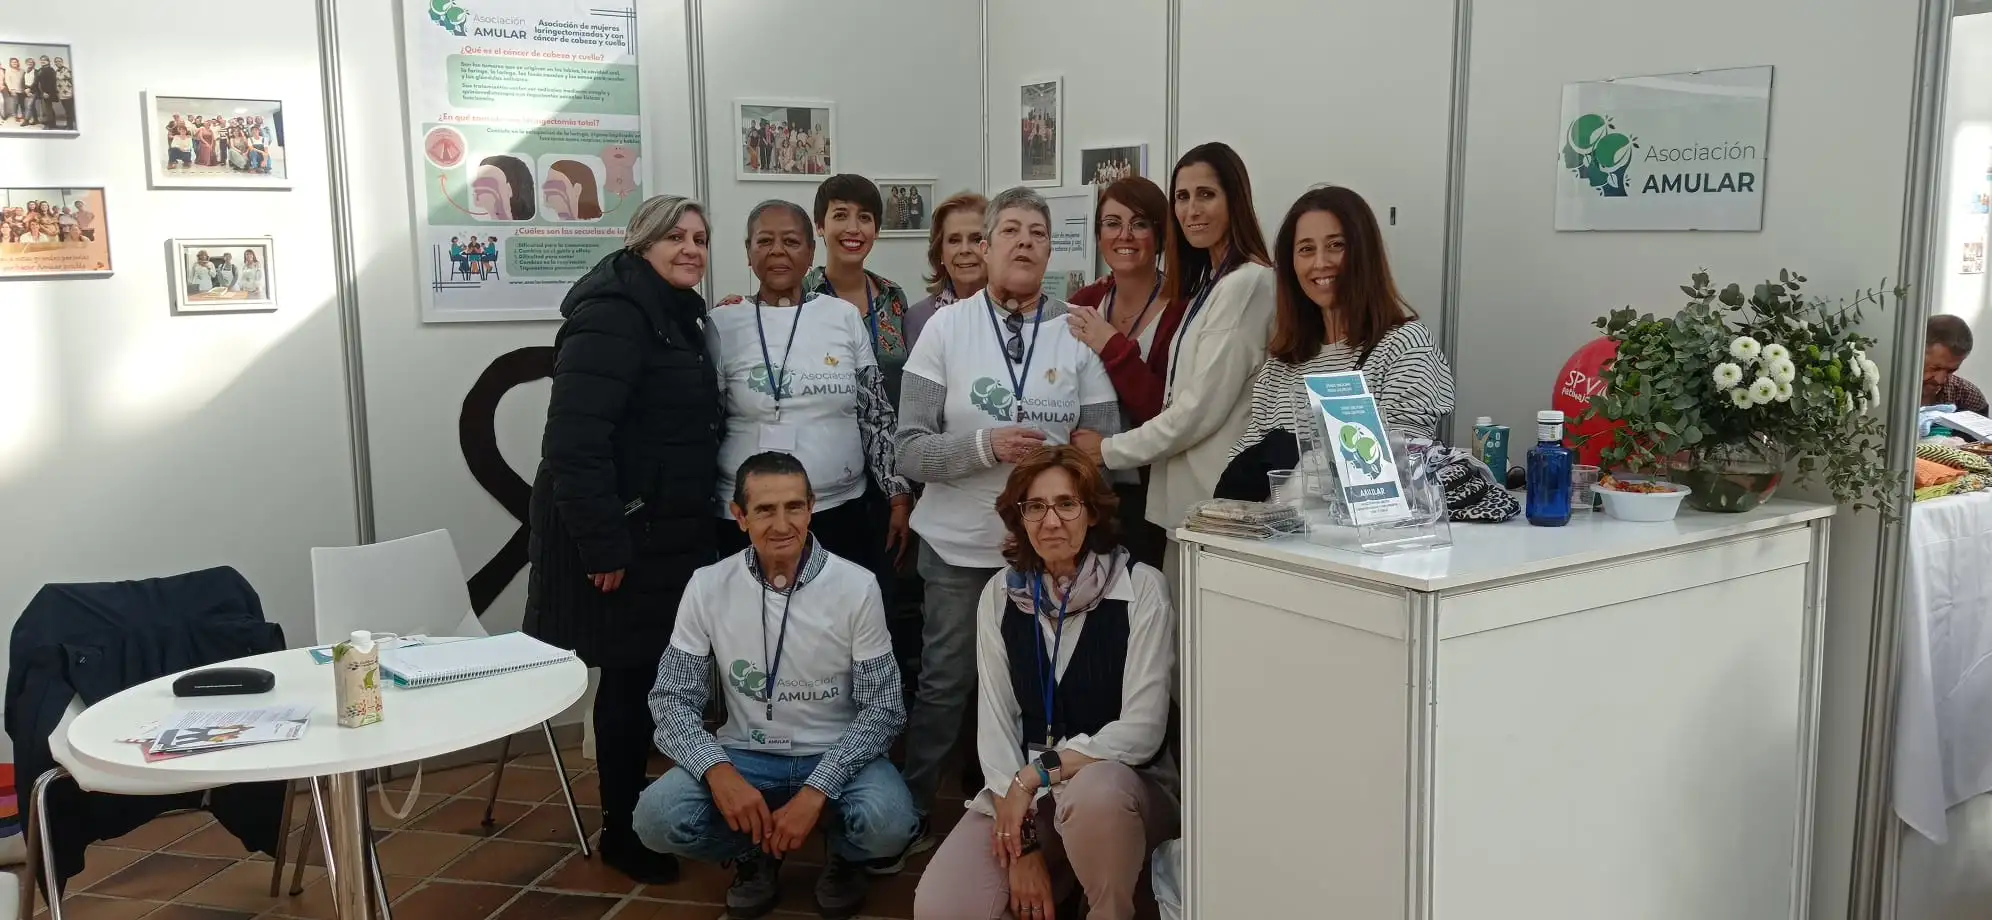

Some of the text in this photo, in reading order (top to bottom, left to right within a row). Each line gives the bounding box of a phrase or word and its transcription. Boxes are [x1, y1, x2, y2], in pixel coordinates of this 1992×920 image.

[473, 13, 526, 25] Asociación
[538, 19, 620, 32] Asociación de mujeres
[474, 27, 527, 40] AMULAR
[604, 32, 610, 40] y
[533, 34, 626, 47] cáncer de cabeza y cuello
[461, 45, 482, 55] ¿Qué
[494, 47, 502, 55] el
[502, 48, 529, 56] cáncer
[531, 49, 541, 57] de
[542, 51, 570, 59] cabeza
[571, 53, 577, 61] y
[578, 53, 605, 62] cuello?
[1644, 141, 1756, 163] Asociación
[1641, 171, 1756, 194] AMULAR
[1022, 410, 1076, 423] AMULAR
[777, 686, 840, 702] AMULAR
